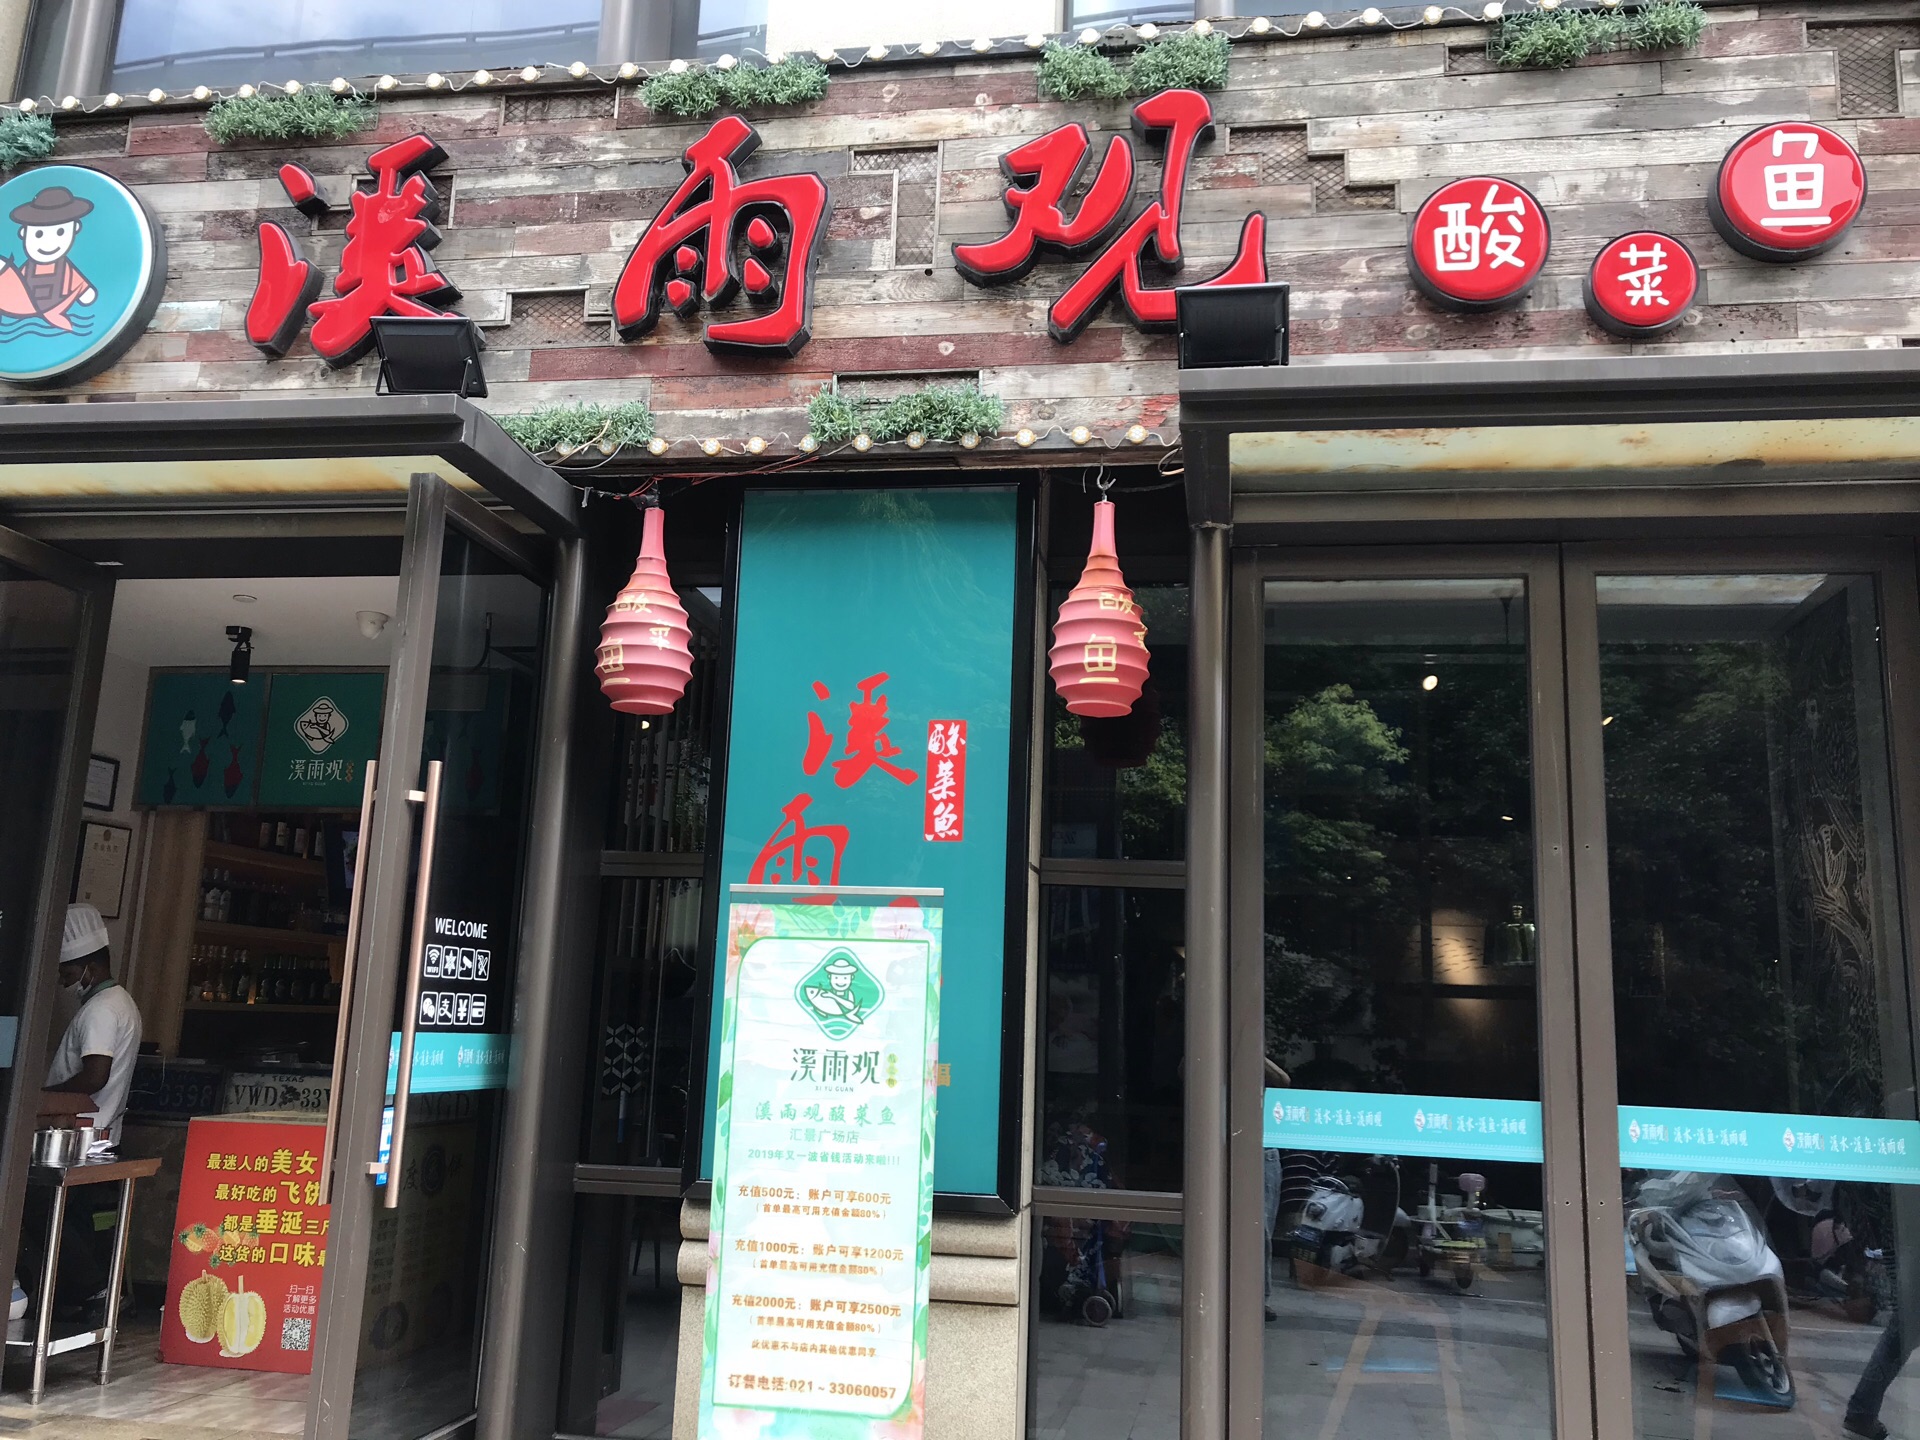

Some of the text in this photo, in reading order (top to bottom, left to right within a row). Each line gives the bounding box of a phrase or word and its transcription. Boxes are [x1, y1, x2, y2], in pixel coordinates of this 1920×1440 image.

[245, 88, 1268, 368] 溪雨观
[1433, 129, 1833, 306] 酸菜鱼
[288, 759, 343, 781] 溪雨观
[747, 671, 919, 906] 溪雨
[435, 917, 488, 939] WELCOME
[790, 1048, 880, 1084] 溪雨观
[272, 1075, 305, 1083] TEXAS
[234, 1084, 278, 1107] VWD
[755, 1100, 896, 1127] 溪雨观酸菜鱼
[206, 1149, 318, 1175] 最迷人的美女
[285, 1294, 317, 1304] 了解更多
[289, 1284, 315, 1295] 扫一扫
[283, 1304, 316, 1315] 活动优惠
